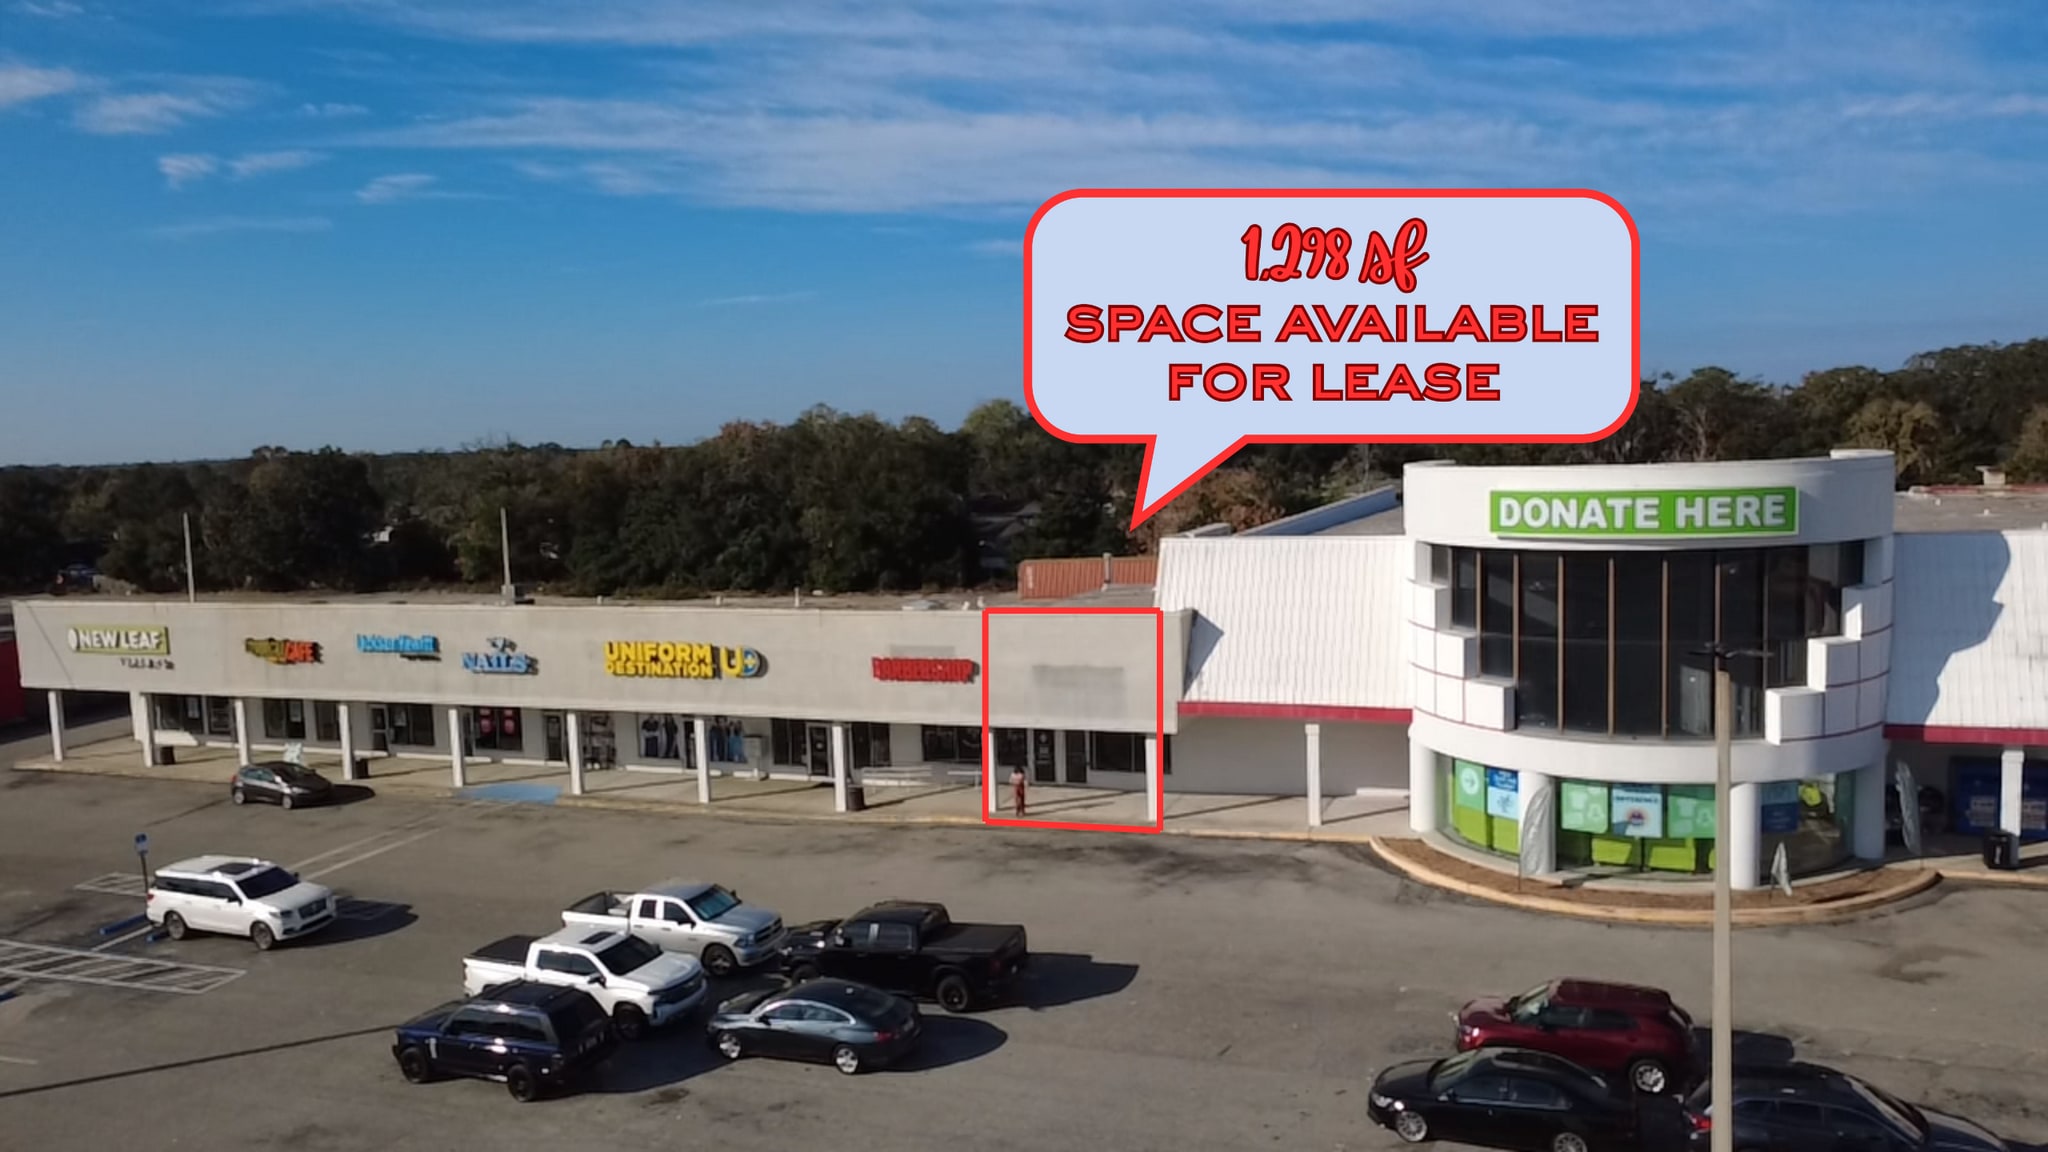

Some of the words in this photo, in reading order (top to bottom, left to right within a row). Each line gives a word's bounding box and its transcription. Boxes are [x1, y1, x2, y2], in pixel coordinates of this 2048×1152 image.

[1500, 496, 1660, 529] DONATE
[1676, 494, 1786, 529] HERE
[80, 632, 116, 649] NEW
[120, 632, 162, 650] LEAF
[604, 641, 713, 663] UNIFORM
[463, 653, 528, 673] NAILS
[605, 662, 714, 679] DESTINATION
